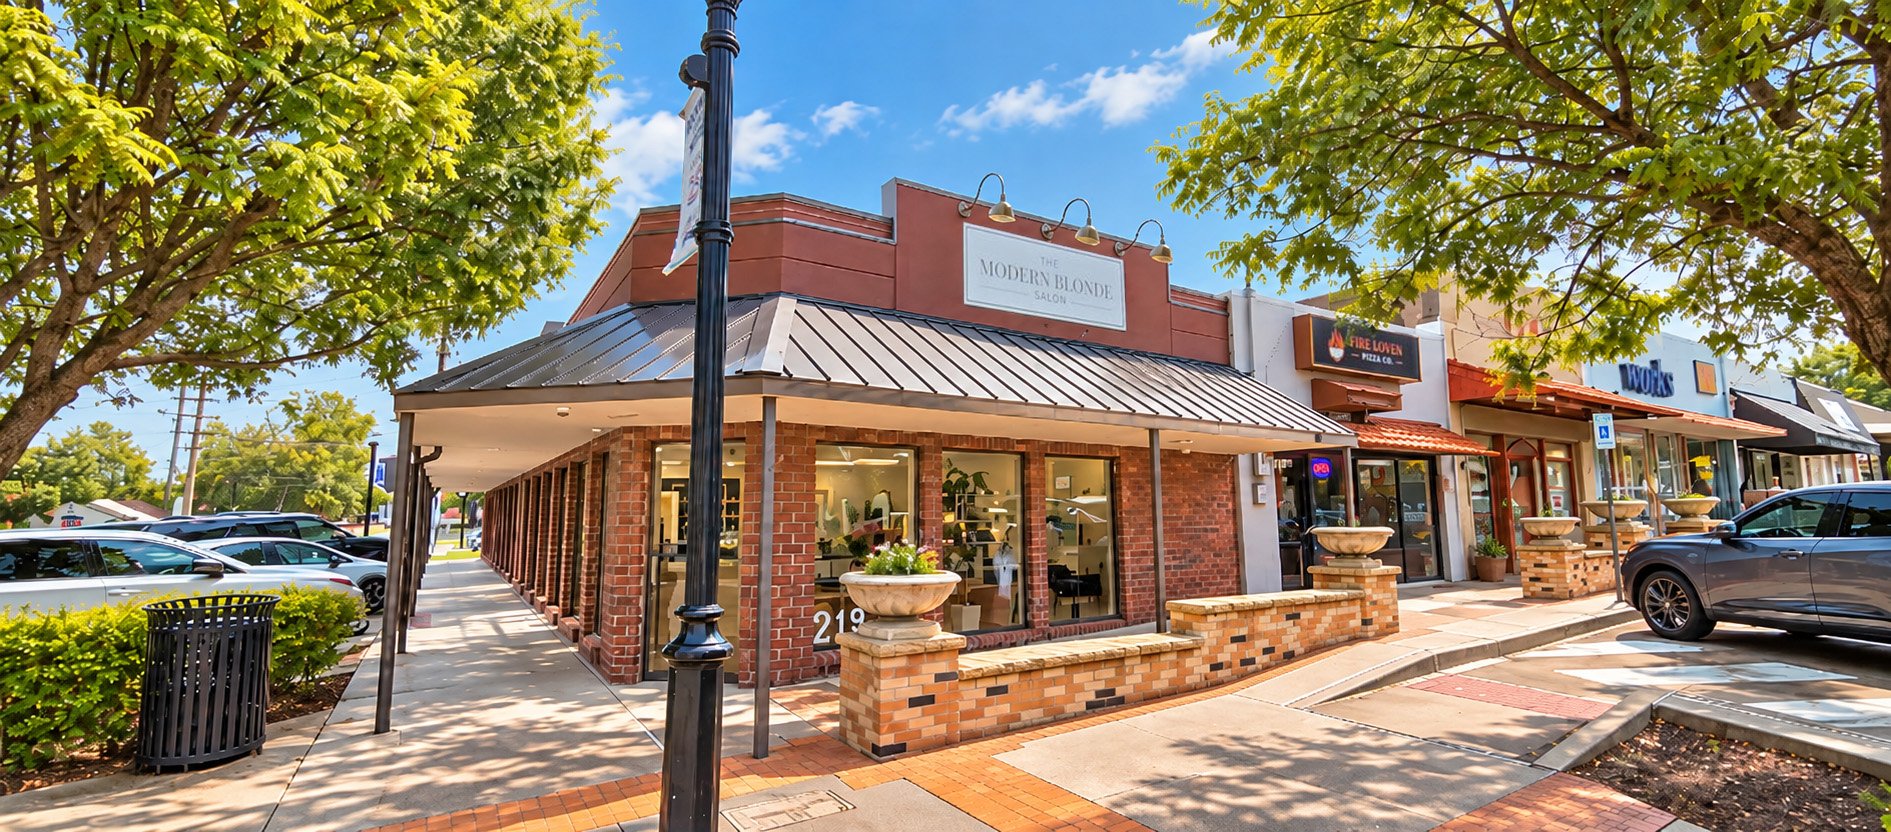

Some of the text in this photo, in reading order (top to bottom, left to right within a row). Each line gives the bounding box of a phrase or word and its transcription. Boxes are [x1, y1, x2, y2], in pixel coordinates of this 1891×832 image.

[1041, 257, 1059, 269] THE
[980, 259, 1114, 300] MODERN BLONDE
[1034, 291, 1067, 304] SALON
[1350, 336, 1403, 356] FIRE LOVEN
[1362, 352, 1394, 365] PIZZA CO.
[813, 607, 865, 644] 219
